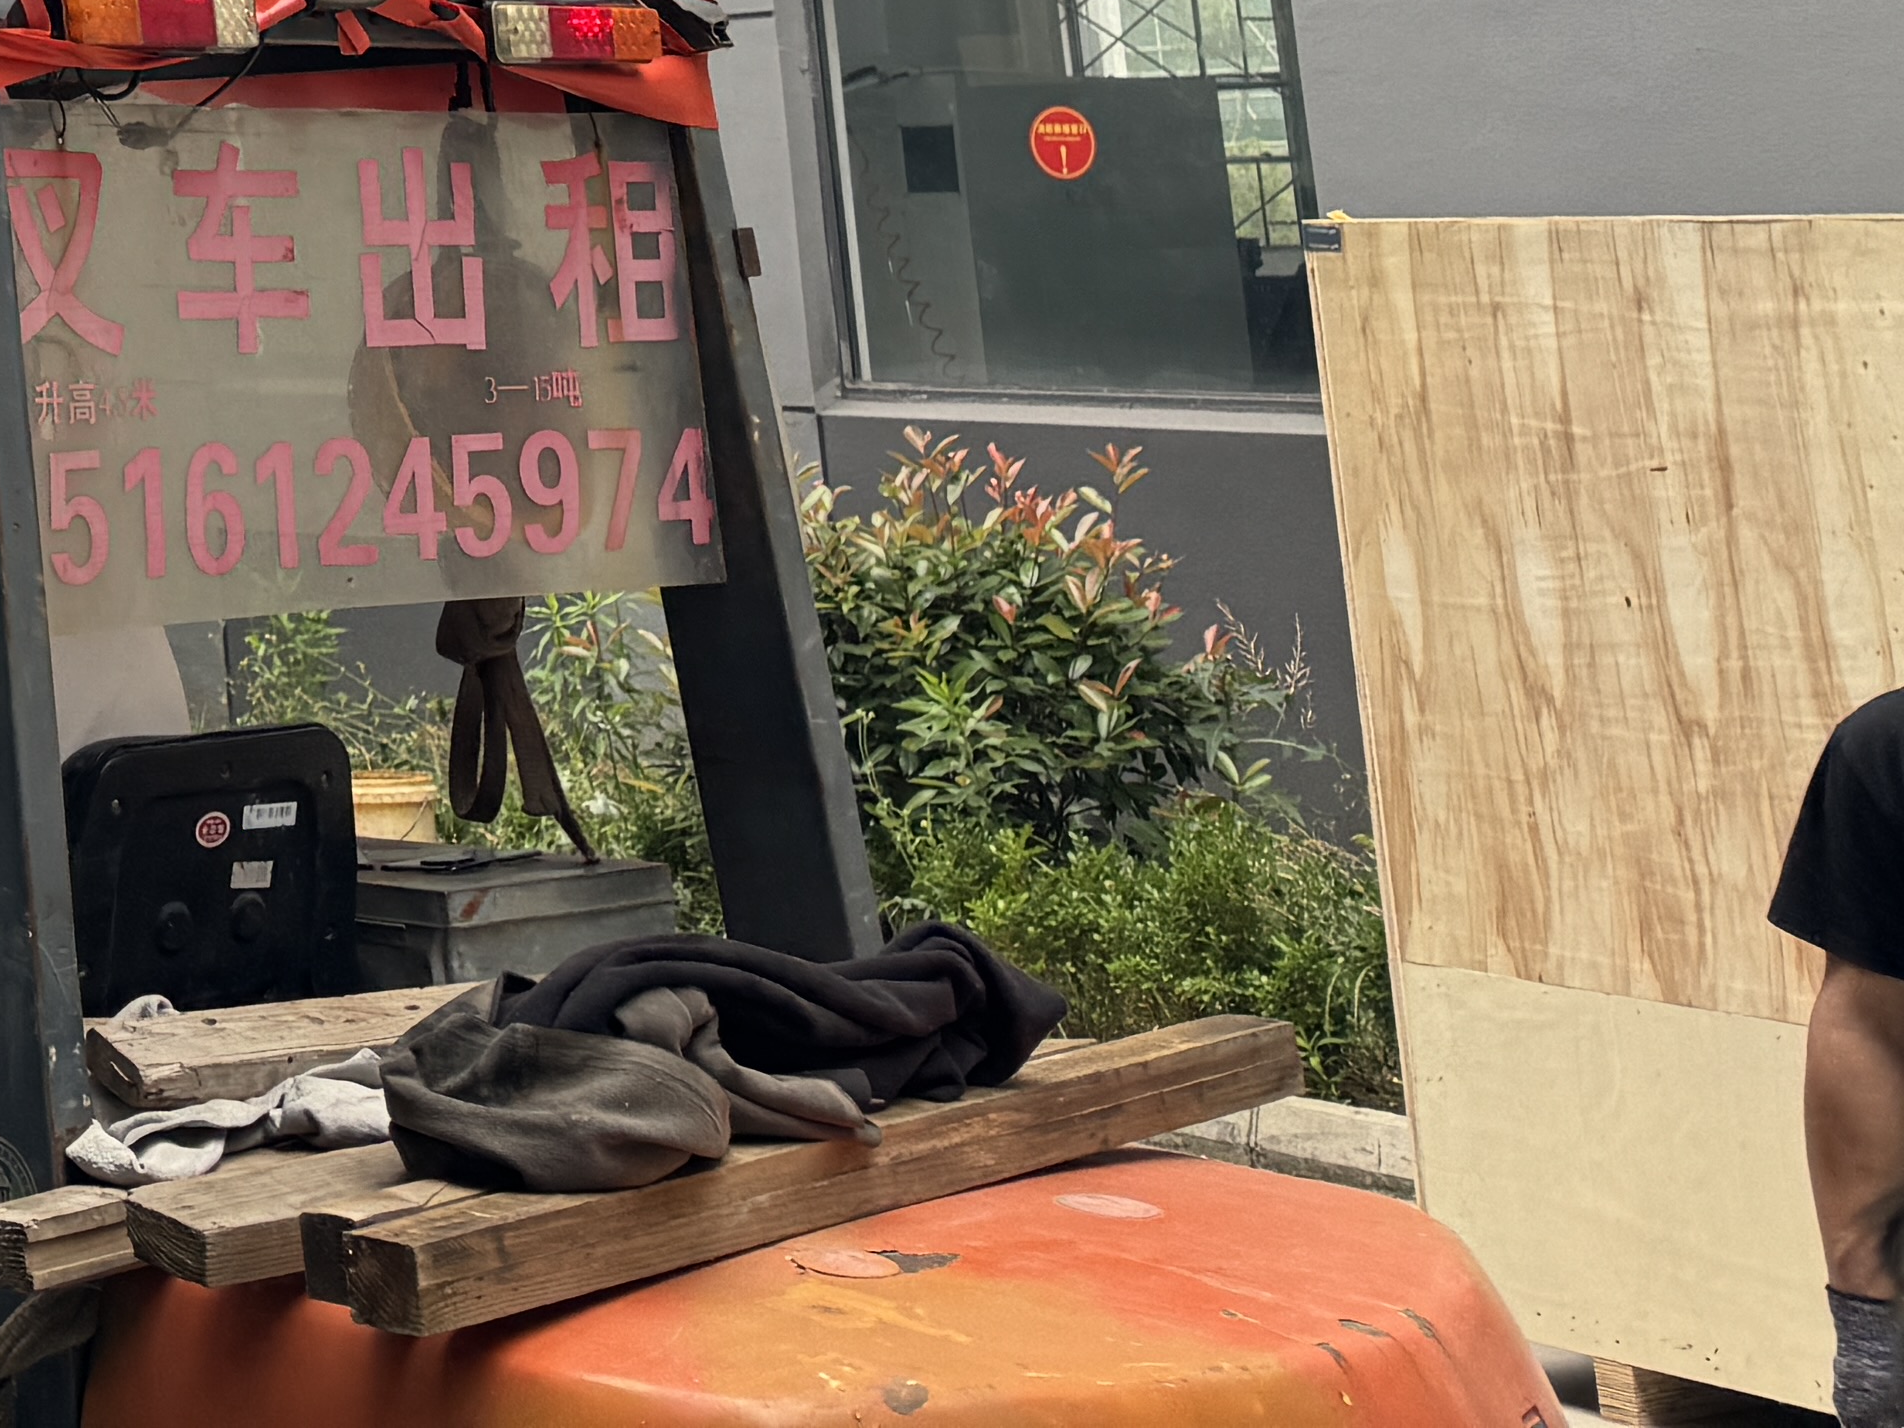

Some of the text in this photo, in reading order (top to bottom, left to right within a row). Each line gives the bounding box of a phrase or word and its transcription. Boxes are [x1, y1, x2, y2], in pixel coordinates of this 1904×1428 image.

[3, 140, 680, 356] 叉车出租
[48, 428, 716, 585] 5161245974
